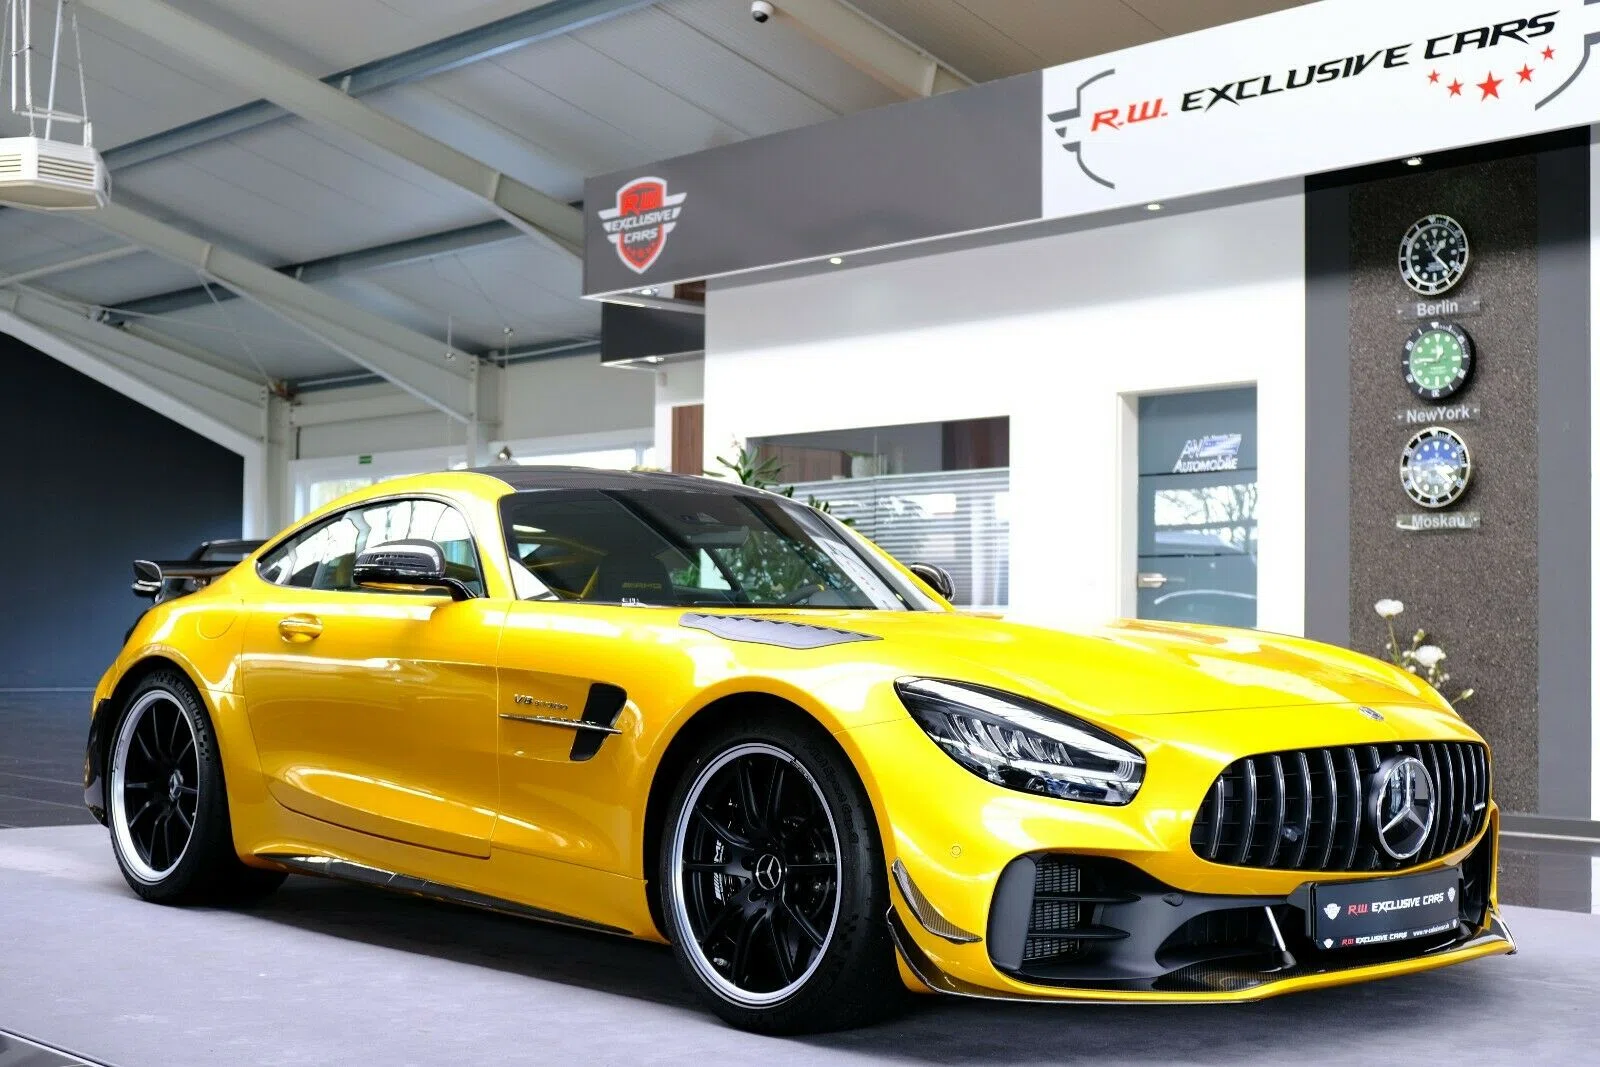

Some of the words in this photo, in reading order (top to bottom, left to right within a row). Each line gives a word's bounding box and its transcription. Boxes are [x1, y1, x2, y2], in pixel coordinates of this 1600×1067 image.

[1091, 98, 1168, 132] R.W.
[1181, 42, 1415, 113] EXCLUSIVE
[1424, 10, 1560, 59] CARS
[612, 209, 672, 232] EXCLUSIVE
[623, 227, 659, 245] CARS
[1417, 299, 1459, 317] Berlin
[1406, 404, 1470, 423] NewYork
[1411, 512, 1466, 528] Moskau
[513, 693, 534, 705] V8
[1372, 897, 1420, 912] EXCLUSIVE
[1423, 892, 1444, 905] CARS
[1390, 932, 1407, 940] CARS
